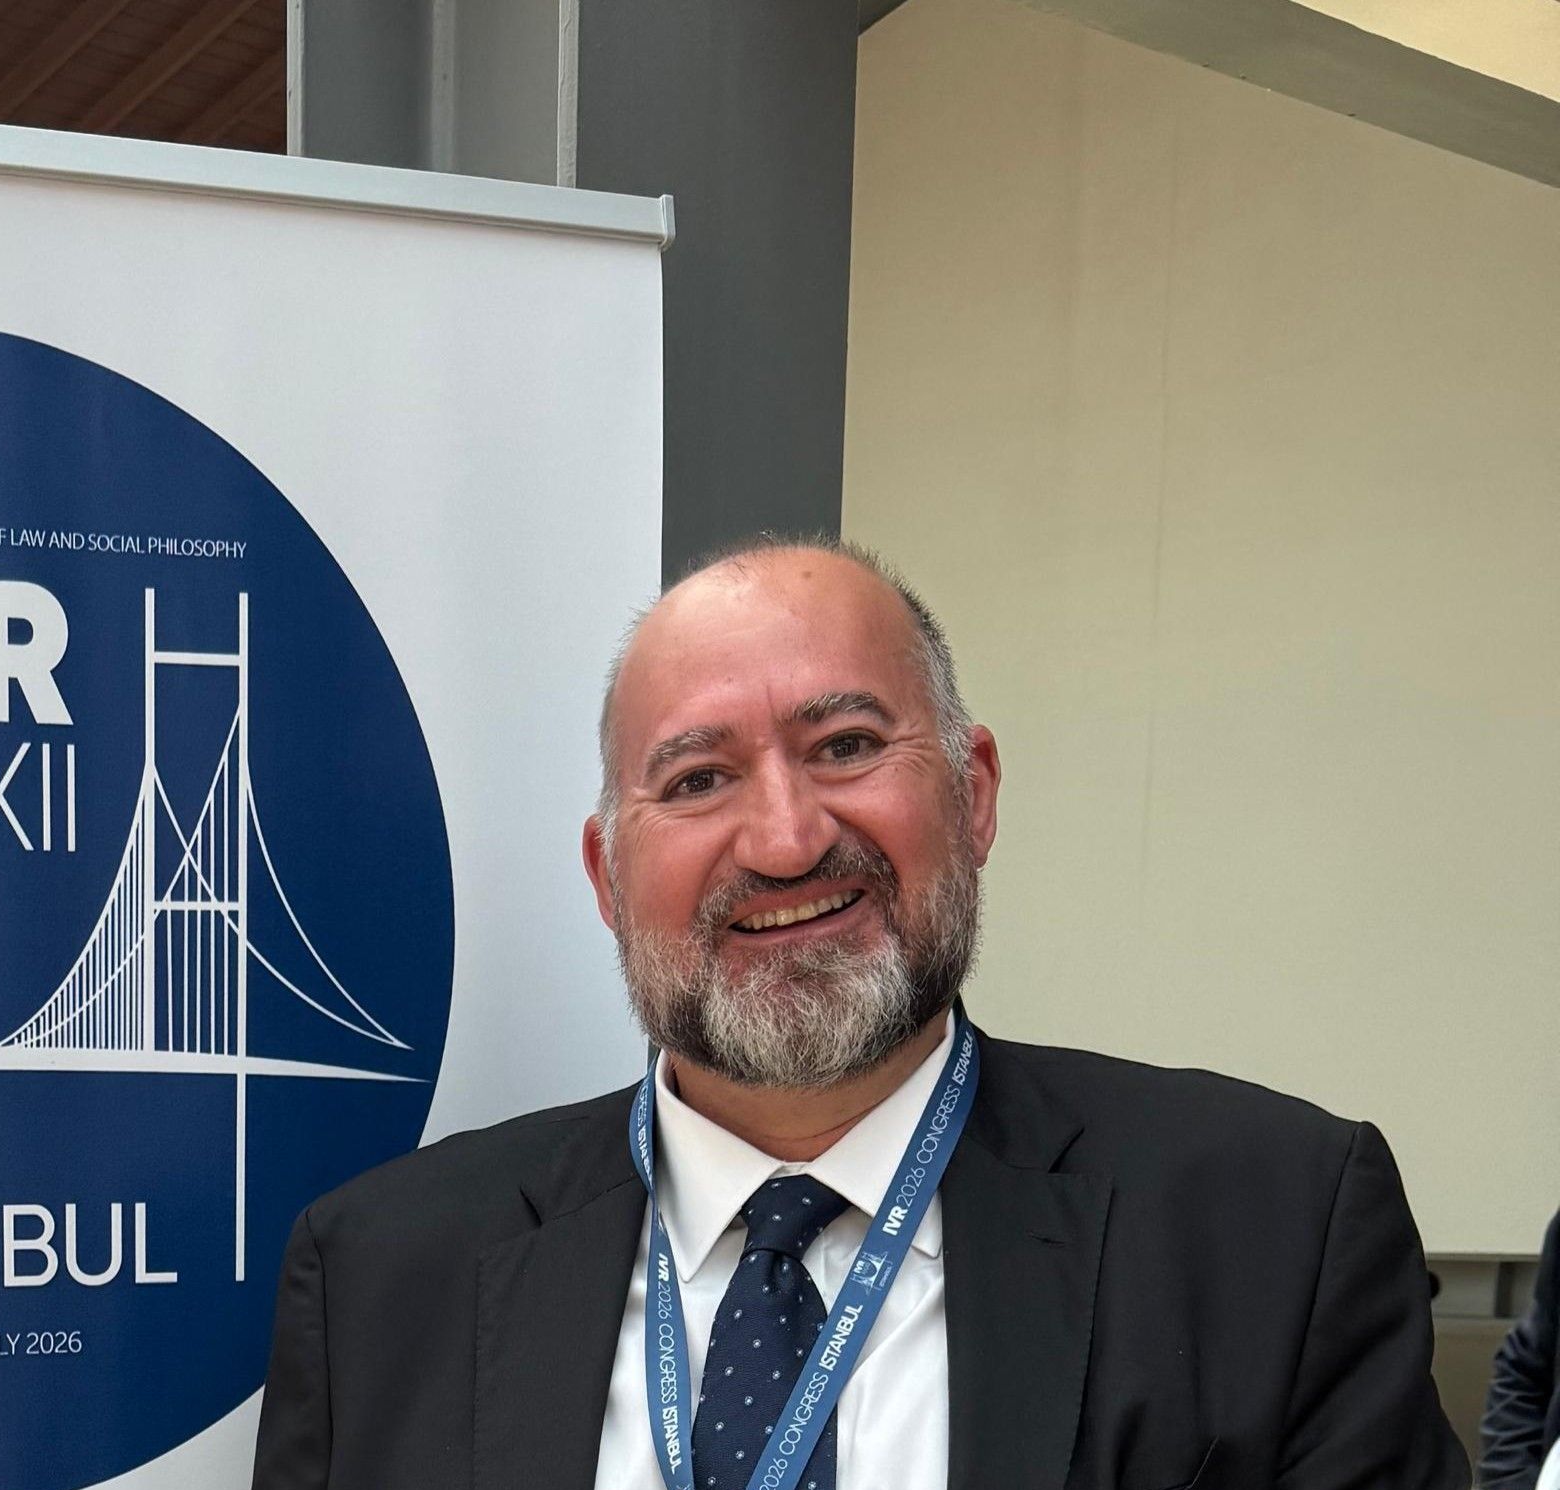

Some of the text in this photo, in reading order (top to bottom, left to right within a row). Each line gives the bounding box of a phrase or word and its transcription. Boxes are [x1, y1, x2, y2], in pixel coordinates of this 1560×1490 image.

[10, 528, 45, 547] LAW
[48, 531, 85, 550] AND
[88, 533, 145, 554] SOCIAL
[148, 537, 247, 559] PHILOSOPHY
[882, 1206, 908, 1236] IVR
[896, 1167, 926, 1207] 2026
[916, 1084, 961, 1164] CONGRESS
[25, 1331, 83, 1355] 2026
[657, 1253, 684, 1476] IVR 2026 CONGRESS ISTANBUL
[779, 1372, 829, 1455] CONGRESS
[819, 1304, 864, 1371] ISTANBUL
